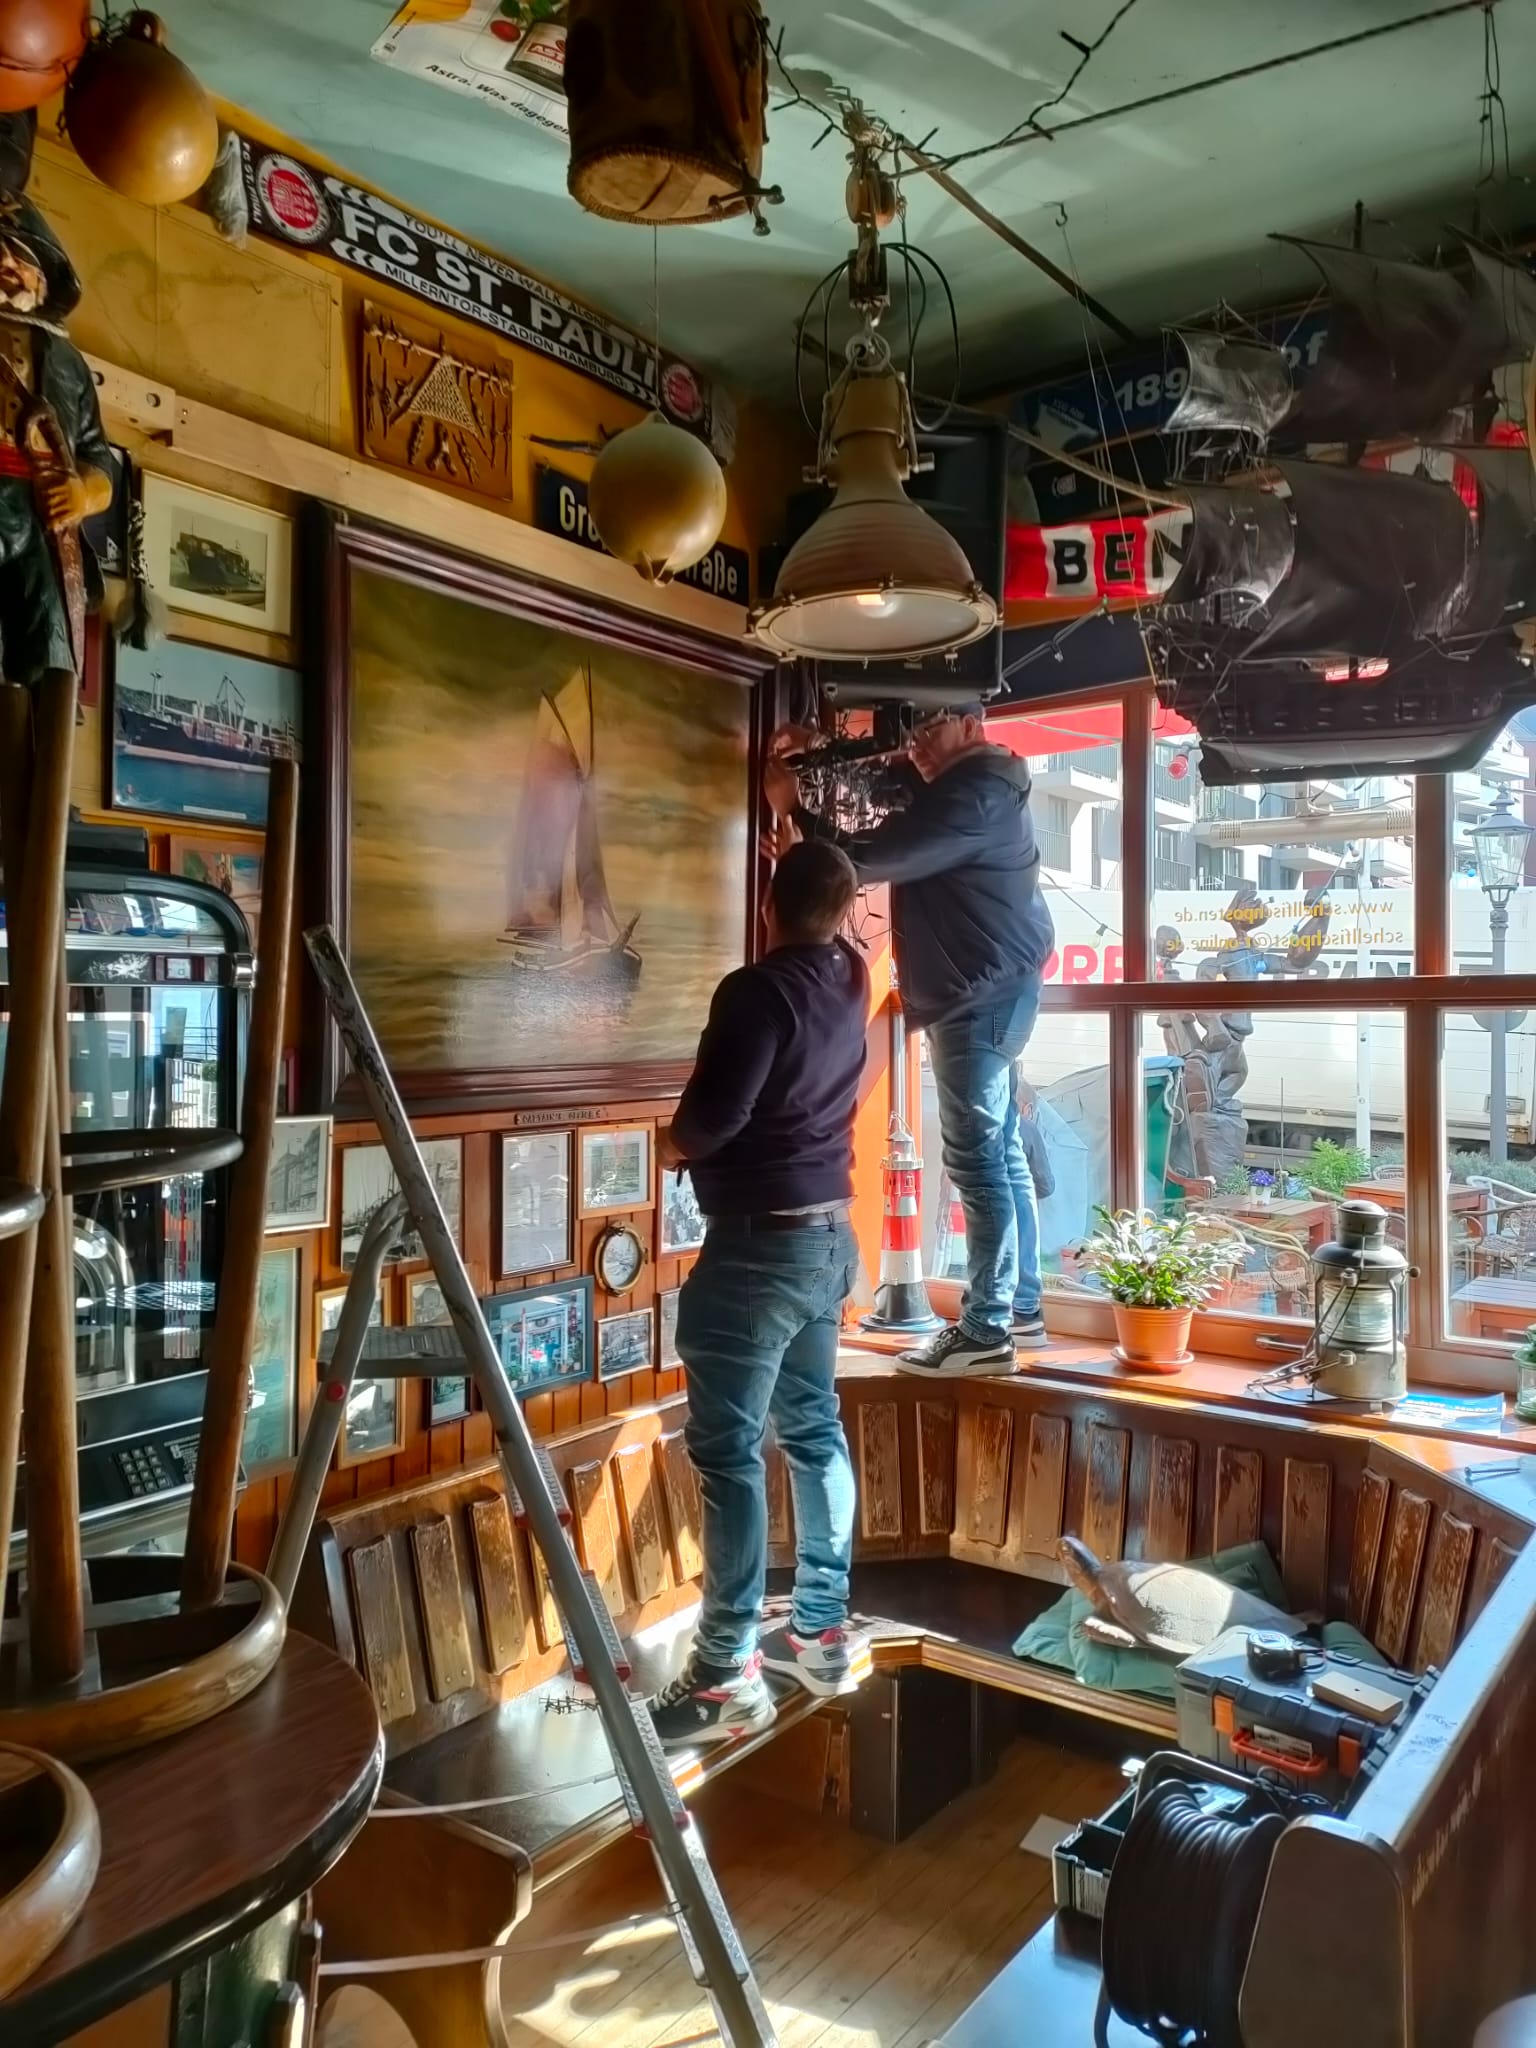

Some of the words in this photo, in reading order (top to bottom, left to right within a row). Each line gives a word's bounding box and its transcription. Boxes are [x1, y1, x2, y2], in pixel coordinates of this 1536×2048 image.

[425, 64, 472, 86] Astra.
[476, 83, 509, 101] Was
[342, 203, 420, 266] FC
[435, 251, 512, 316] ST.
[530, 296, 656, 388] PAULI
[404, 214, 458, 250] YOU'LL
[466, 246, 514, 281] NEVER
[518, 275, 562, 306] WALK
[385, 263, 554, 351] MILLERNTOR-STADION
[558, 346, 625, 387] HAMBURG
[1115, 367, 1188, 411] 189
